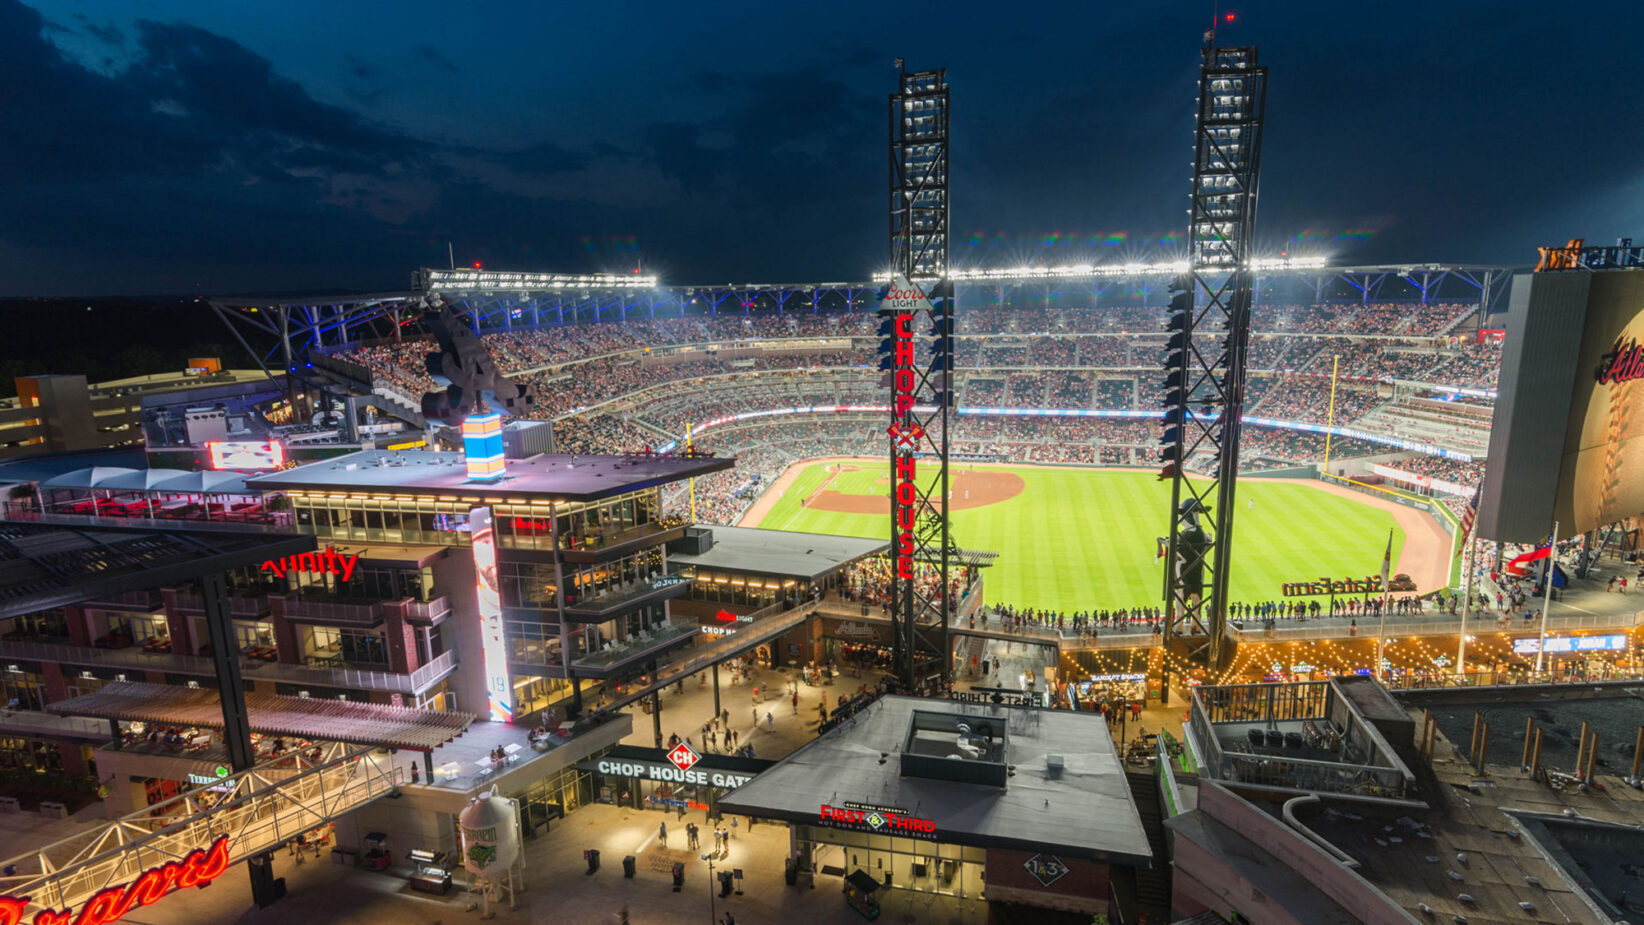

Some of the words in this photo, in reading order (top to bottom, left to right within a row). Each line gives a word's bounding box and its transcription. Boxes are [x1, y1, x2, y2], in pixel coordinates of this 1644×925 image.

[885, 283, 924, 300] Coors
[892, 299, 918, 308] LIGHT
[895, 313, 915, 418] CHOP
[896, 456, 916, 580] HOUSE
[701, 625, 725, 635] CHOP
[491, 675, 505, 692] 19
[672, 750, 693, 765] CH
[597, 760, 645, 778] CHOP
[649, 766, 708, 785] HOUSE
[711, 773, 752, 789] GAT
[820, 804, 866, 824] FIRST
[869, 815, 881, 825] &
[884, 812, 936, 833] THIRD
